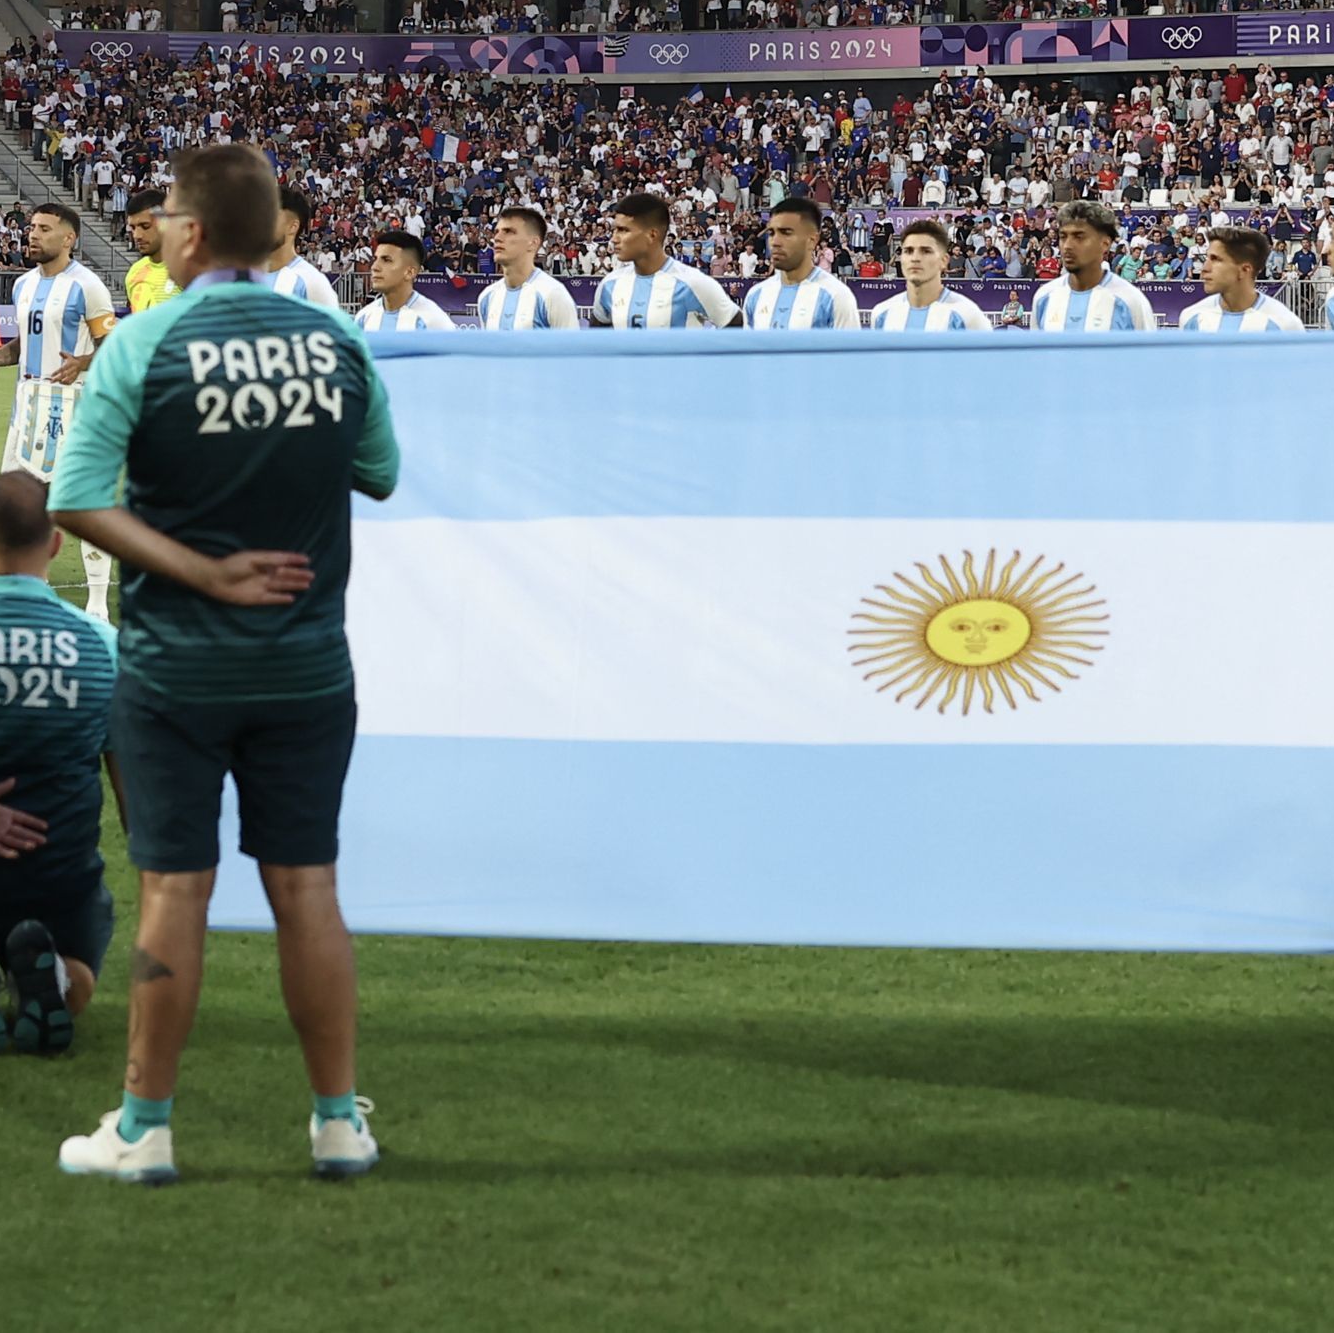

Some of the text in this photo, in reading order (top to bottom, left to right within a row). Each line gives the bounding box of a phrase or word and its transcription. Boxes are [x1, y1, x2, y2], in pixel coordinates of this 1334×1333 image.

[292, 45, 365, 65] 2024
[829, 38, 893, 60] 2024
[27, 309, 43, 335] 16
[195, 376, 343, 435] 2024
